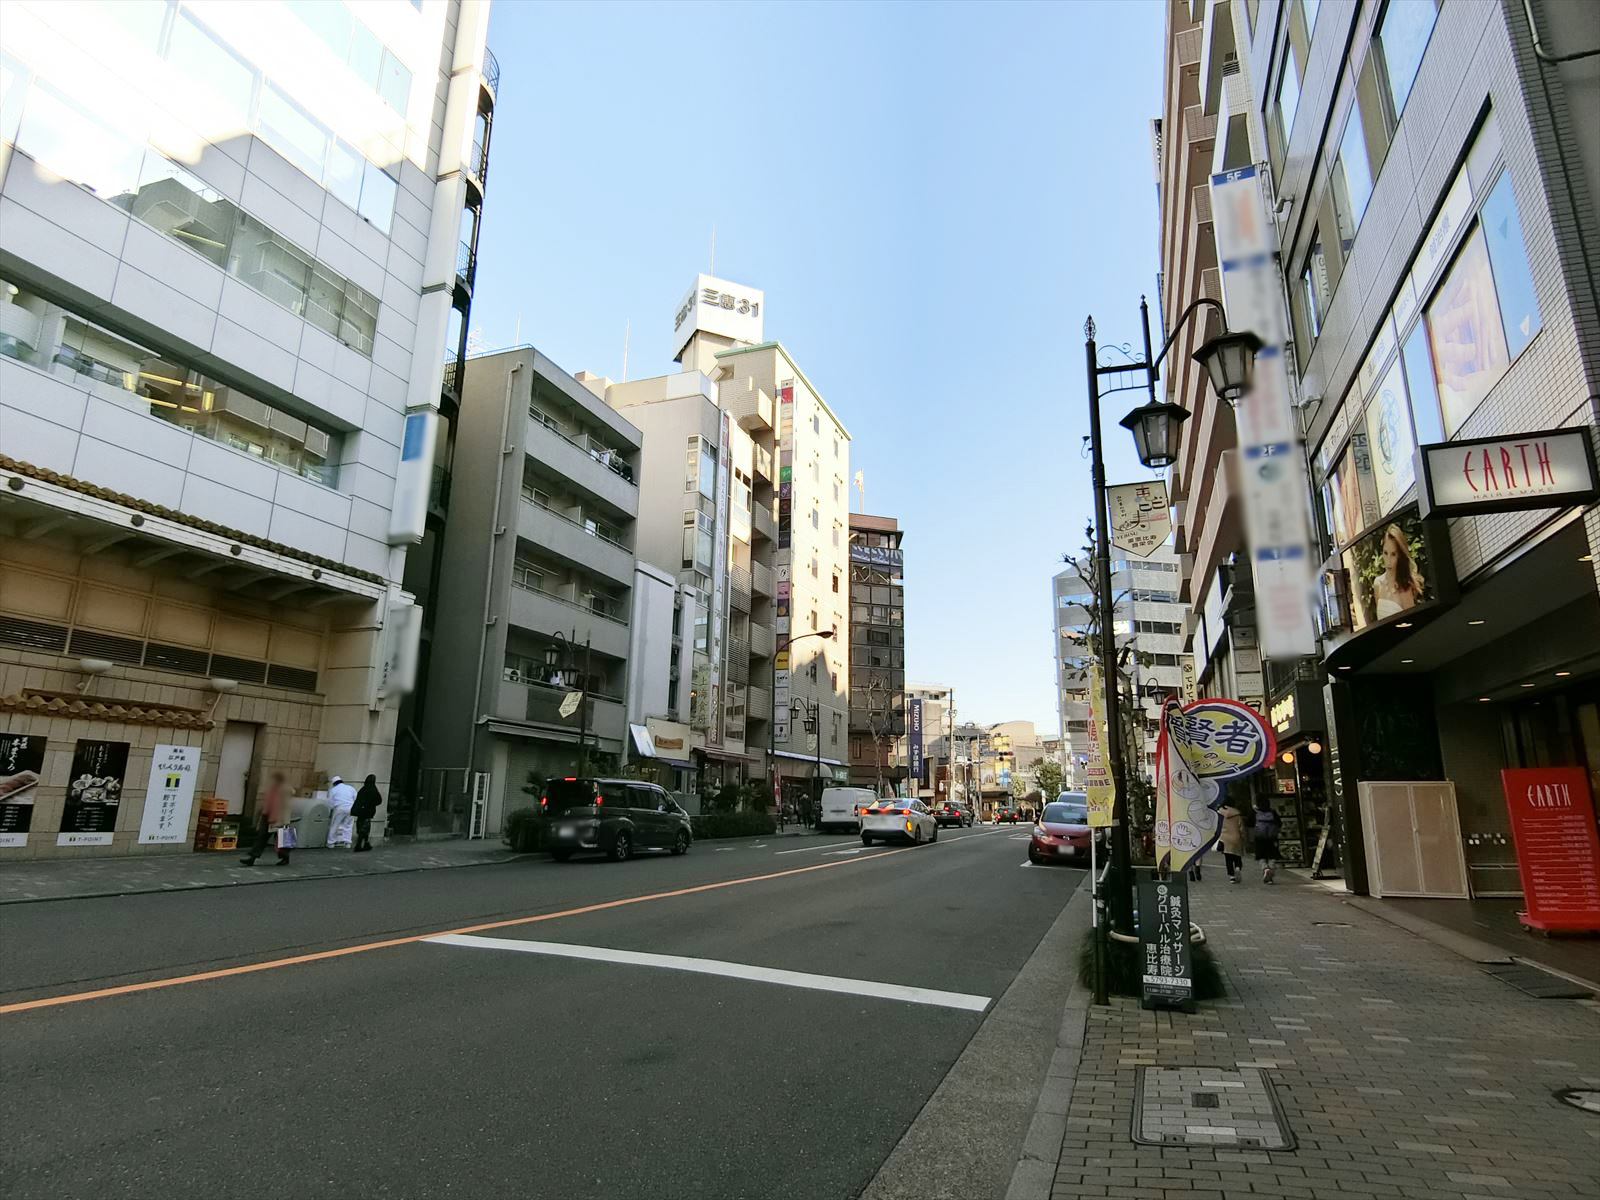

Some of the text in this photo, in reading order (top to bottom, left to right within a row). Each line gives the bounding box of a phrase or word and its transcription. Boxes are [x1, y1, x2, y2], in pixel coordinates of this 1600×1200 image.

[1226, 171, 1242, 183] 5F
[1463, 442, 1555, 492] EARTH
[1527, 784, 1571, 807] EARTH
[1146, 943, 1158, 976] 恵比寿
